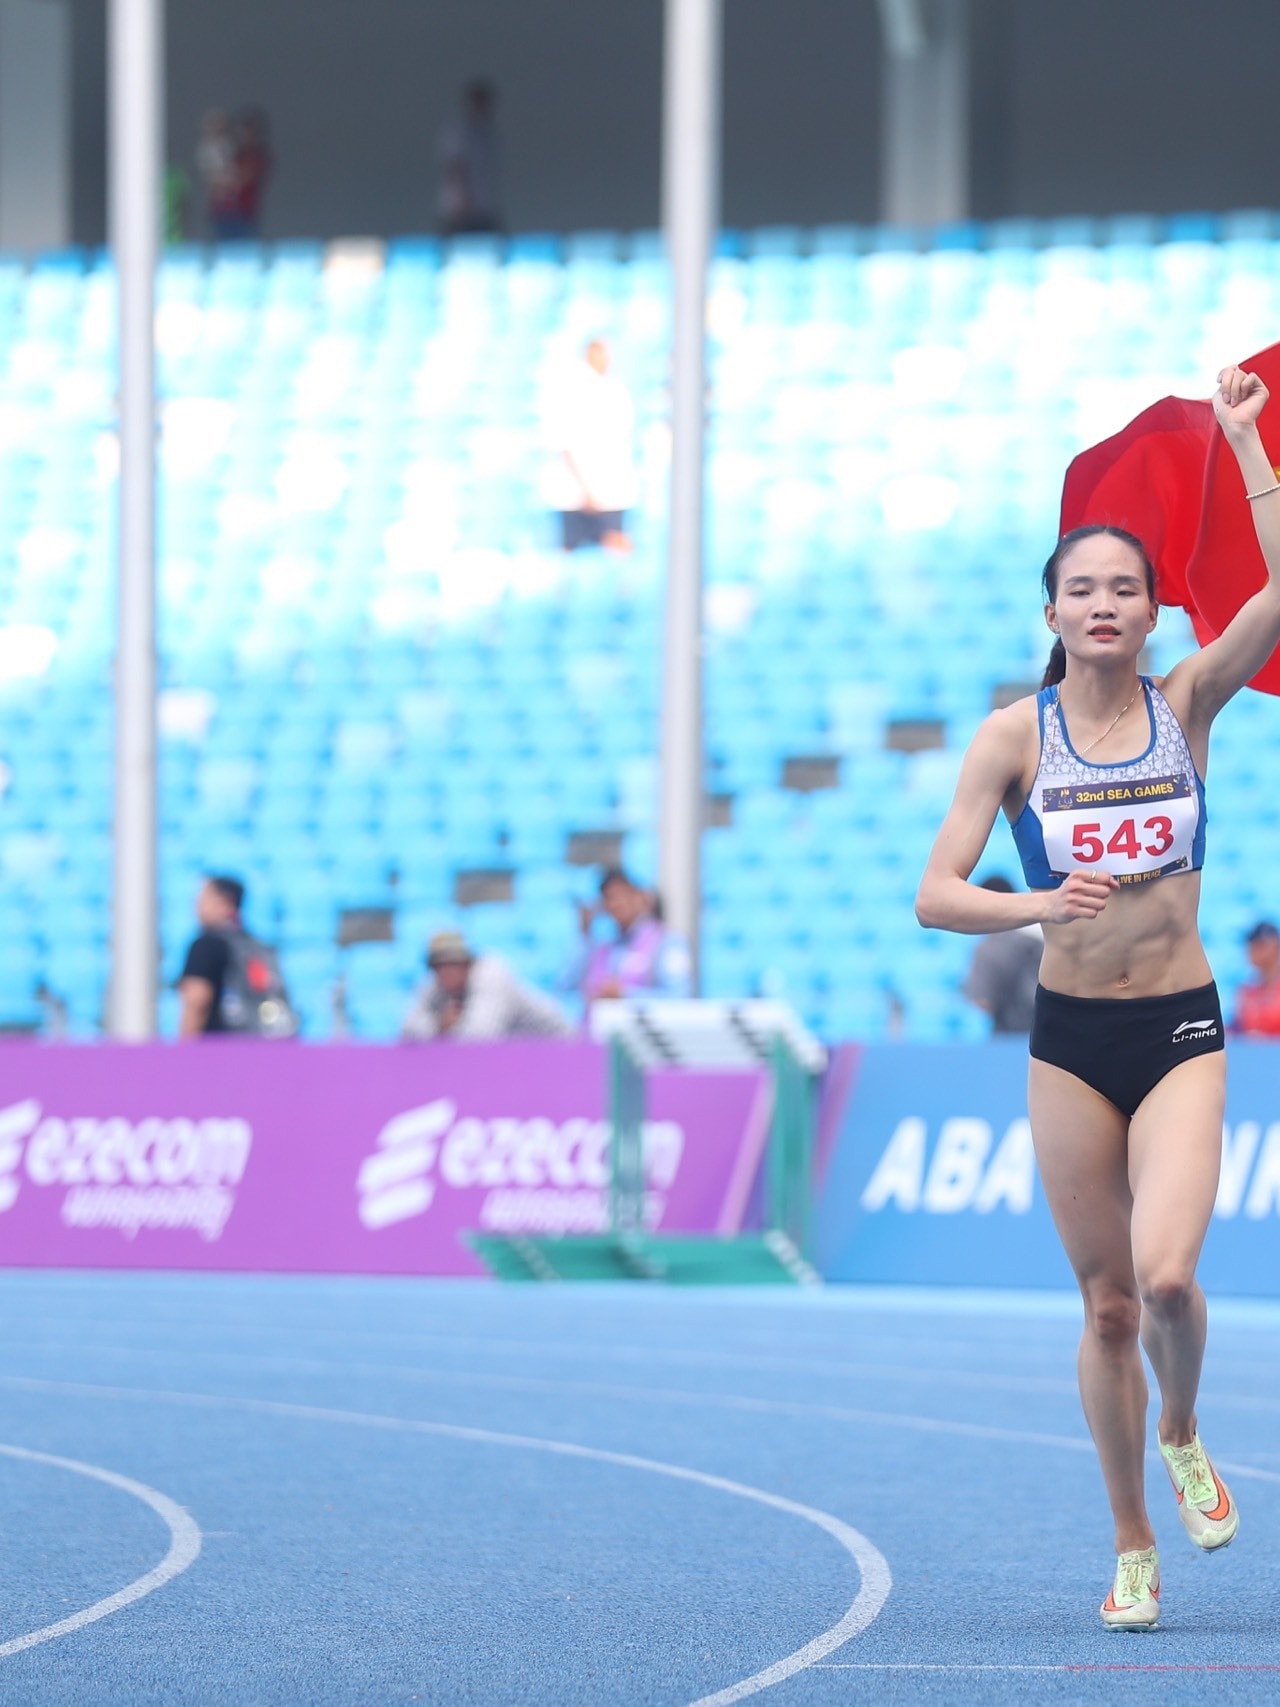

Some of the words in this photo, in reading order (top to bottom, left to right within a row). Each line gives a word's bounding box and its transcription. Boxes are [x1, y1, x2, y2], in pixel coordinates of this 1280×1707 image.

[1076, 790, 1105, 803] 32nd
[1107, 789, 1132, 800] SEA
[1134, 783, 1175, 798] GAMES
[1072, 815, 1174, 864] 543
[1133, 873, 1142, 883] IN
[1143, 869, 1162, 881] PEACE
[1172, 1028, 1217, 1043] LI-NING
[26, 1117, 252, 1186] ezecom
[861, 1117, 1036, 1214] ABA
